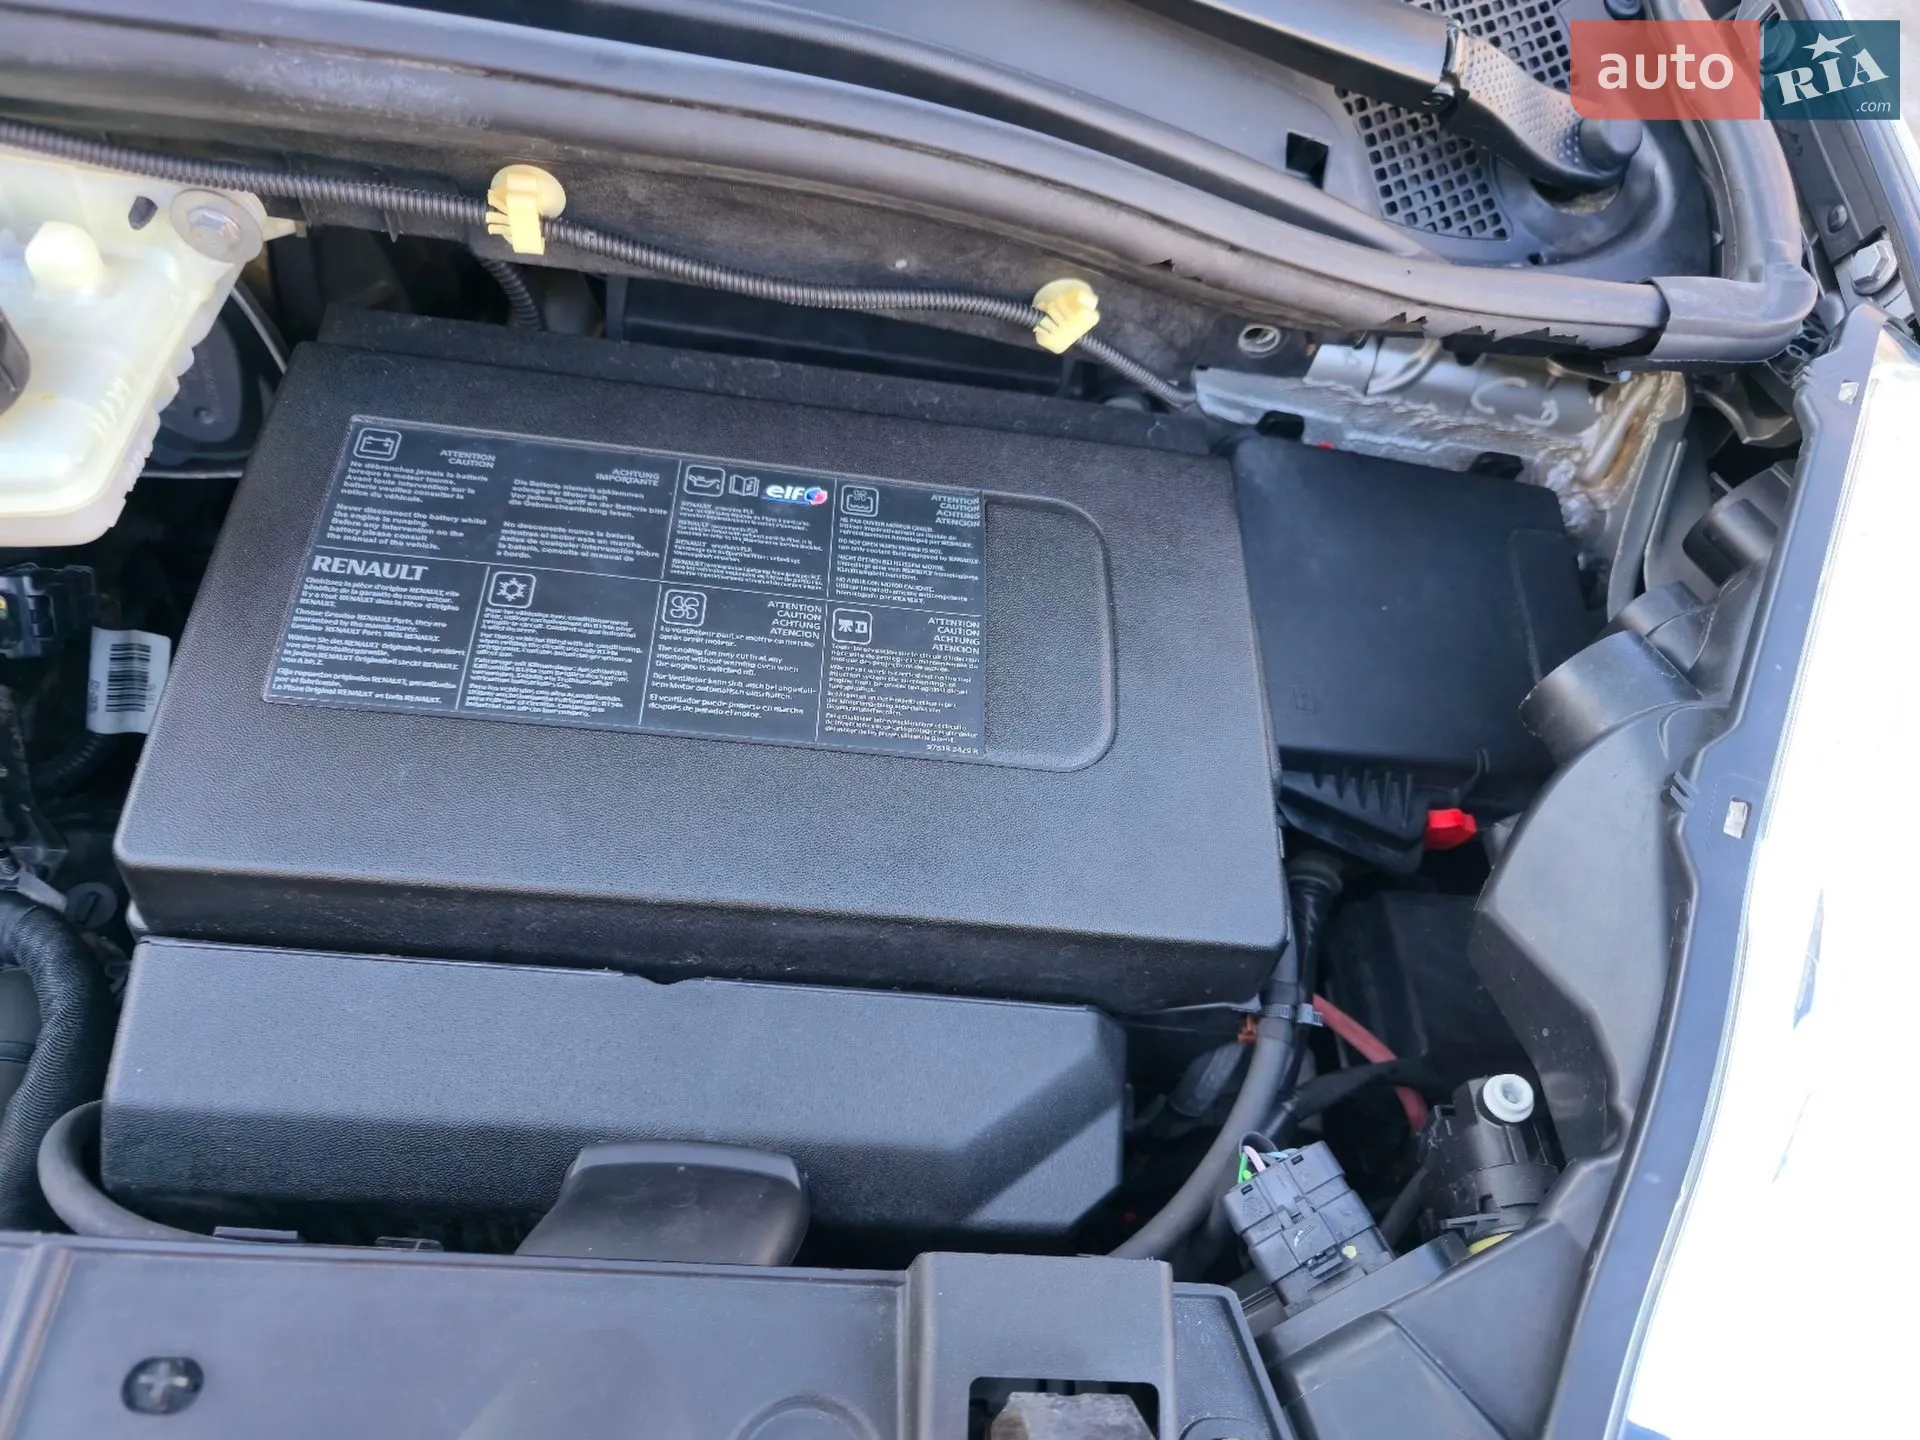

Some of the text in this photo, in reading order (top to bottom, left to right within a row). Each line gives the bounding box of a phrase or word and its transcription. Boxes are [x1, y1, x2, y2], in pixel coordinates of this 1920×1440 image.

[440, 450, 495, 461] ATTENTION
[448, 458, 494, 468] CAUTION
[596, 473, 658, 486] IMPORTANTE
[612, 469, 659, 479] ACHTUNG
[766, 485, 806, 500] elf
[931, 494, 979, 505] ATTENTION
[940, 501, 979, 512] CAUTION
[936, 510, 980, 519] ACHTUNG
[935, 517, 980, 527] ATENCION
[313, 556, 427, 580] RENAULT
[767, 601, 821, 612] ATTENTION
[777, 610, 821, 620] CAUTION
[771, 618, 820, 630] ACHTUNG
[928, 617, 979, 628] ATTENTION
[770, 627, 819, 639] ATENCION
[937, 626, 979, 636] CAUTION
[933, 635, 980, 645] ACHTUNG
[932, 644, 979, 654] ATENCION
